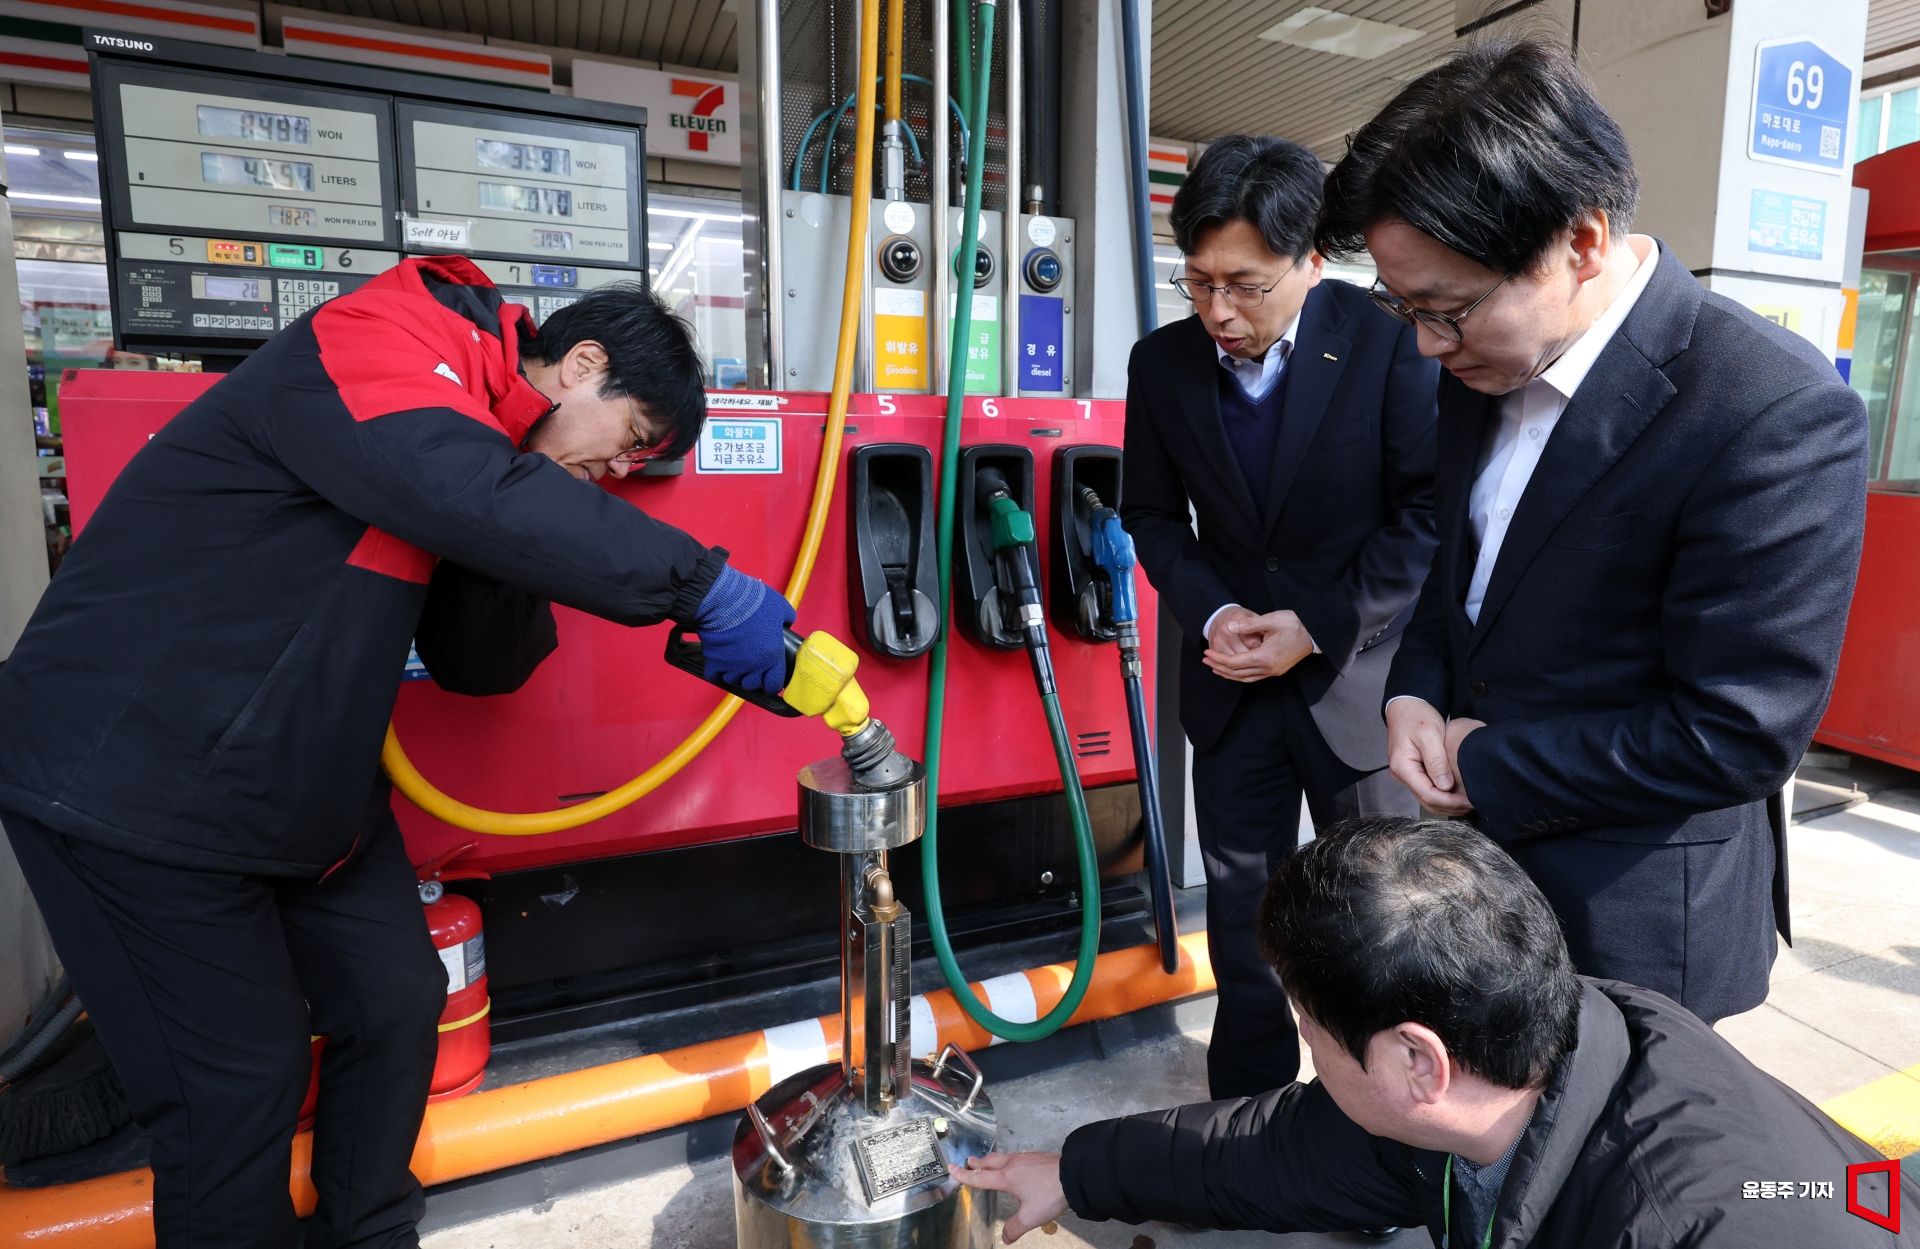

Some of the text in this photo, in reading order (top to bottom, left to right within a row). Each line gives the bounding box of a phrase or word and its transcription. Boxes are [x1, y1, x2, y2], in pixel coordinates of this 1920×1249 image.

[93, 34, 153, 51] TATSUNO
[1787, 60, 1824, 110] 69
[1762, 113, 1801, 133] 마포대로
[318, 129, 343, 140] WON
[1761, 134, 1802, 153] Mapo-daero
[575, 160, 597, 170] WON
[321, 175, 357, 186] LITERS
[577, 201, 607, 212] LITERS
[280, 208, 310, 225] 1827
[324, 216, 342, 224] WON
[358, 218, 377, 227] LITER
[410, 226, 460, 241] Self 아님
[169, 238, 185, 256] 5
[338, 250, 353, 268] 6
[509, 265, 520, 283] 7
[282, 281, 289, 290] 7
[297, 282, 305, 291] 8
[312, 283, 320, 292] 9
[282, 294, 321, 305] 4 5 6
[284, 307, 289, 316] 1
[195, 315, 273, 328] P1 P2 P3 P4 P5
[885, 341, 919, 356] 휘발유
[968, 346, 990, 360] 발유
[1026, 343, 1057, 357] 경 유
[885, 366, 918, 376] gasoline
[965, 370, 986, 380] olux
[1031, 367, 1052, 377] diesel
[877, 395, 897, 415] 5
[981, 398, 999, 418] 6
[1077, 400, 1092, 419] 7
[724, 427, 754, 439] 화물차
[713, 442, 765, 454] 유가보조금
[713, 453, 765, 465] 지급 주유소
